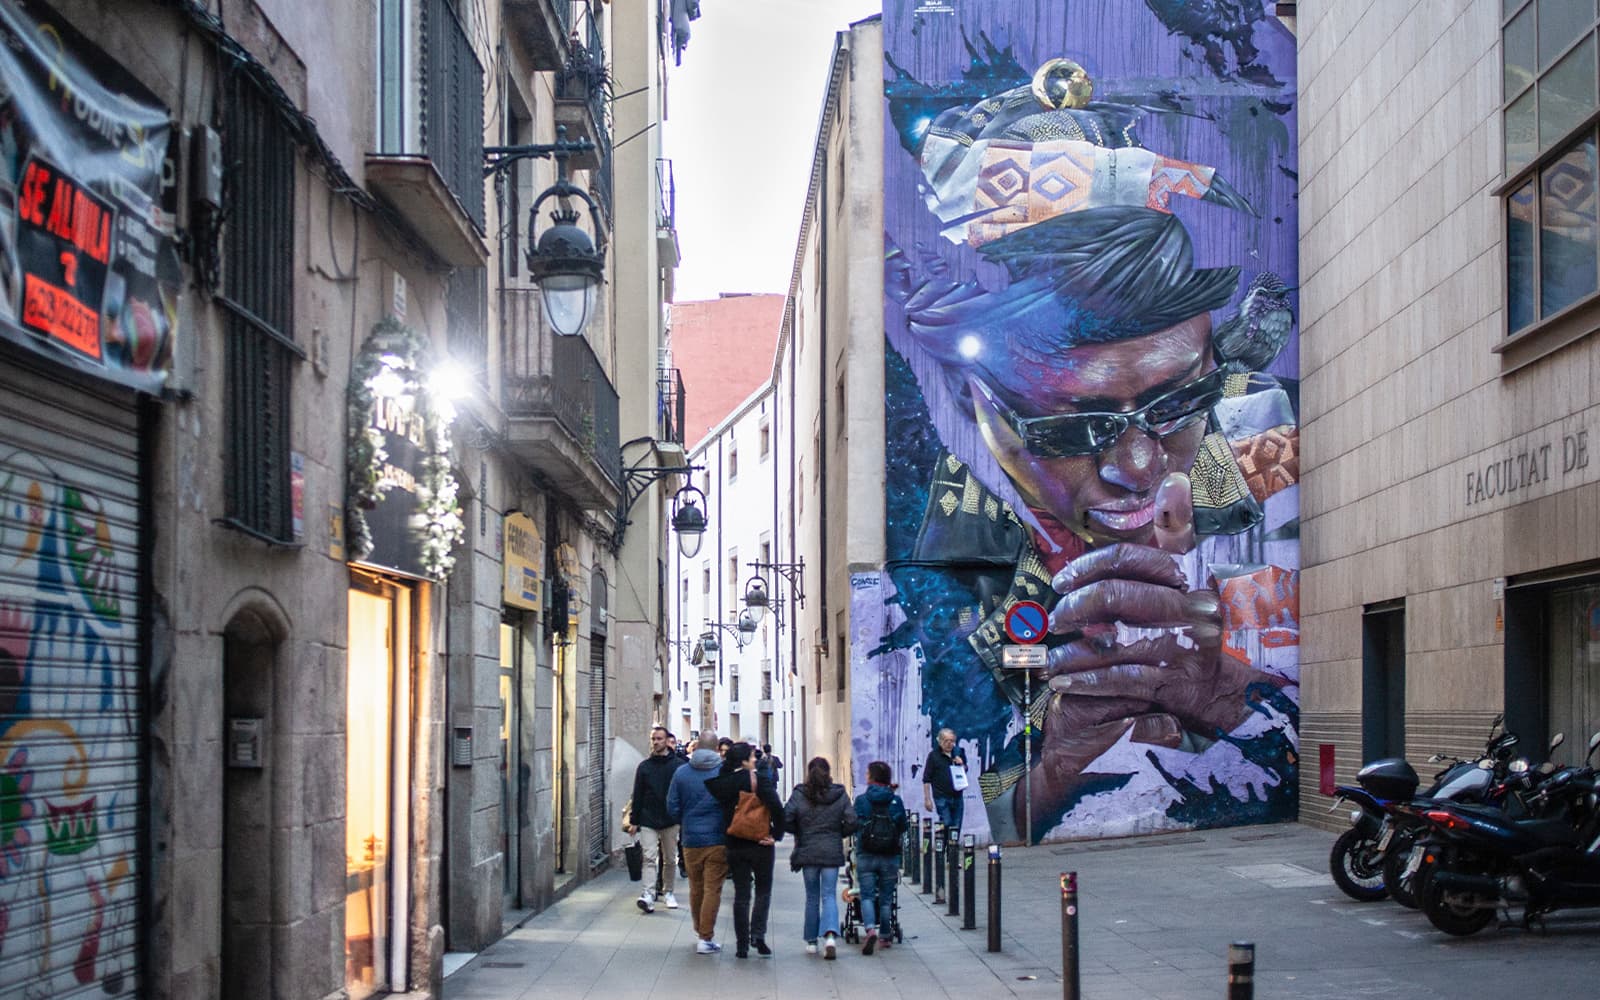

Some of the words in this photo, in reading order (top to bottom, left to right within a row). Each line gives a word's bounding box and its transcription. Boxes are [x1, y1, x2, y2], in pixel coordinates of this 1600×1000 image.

[18, 161, 50, 226] SE
[1466, 442, 1552, 506] FACULTAT
[1563, 430, 1590, 476] DE
